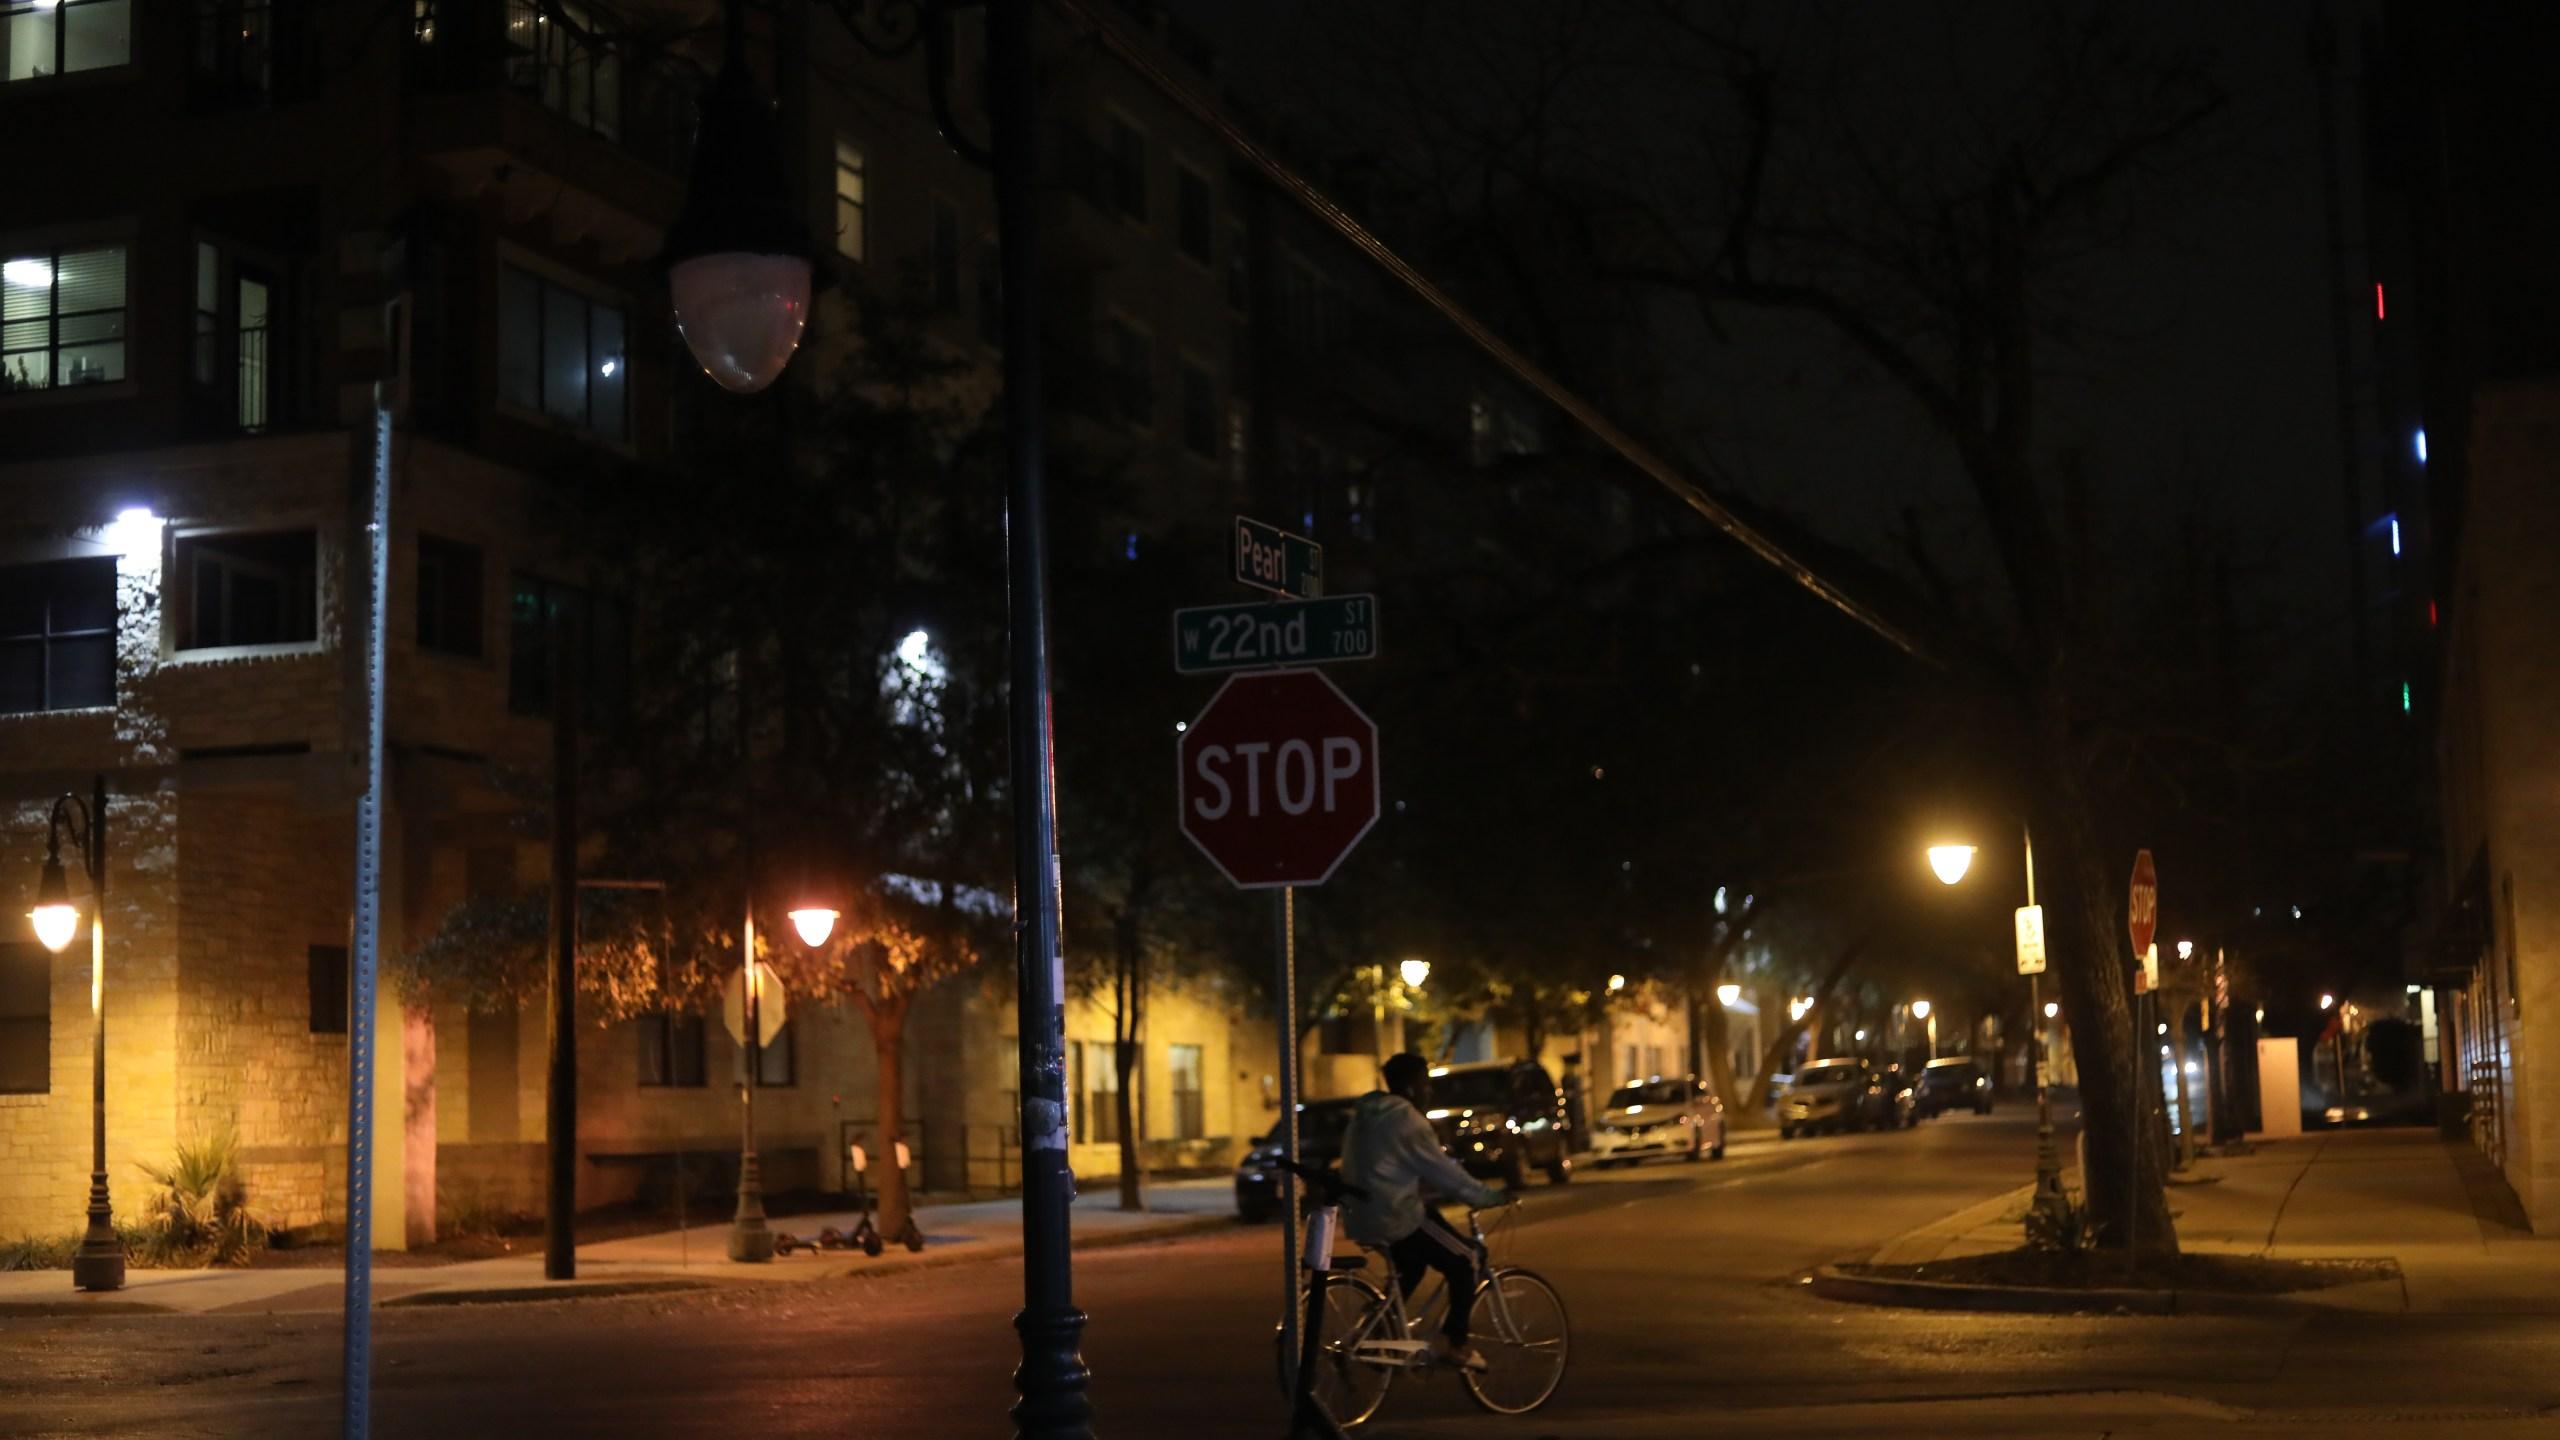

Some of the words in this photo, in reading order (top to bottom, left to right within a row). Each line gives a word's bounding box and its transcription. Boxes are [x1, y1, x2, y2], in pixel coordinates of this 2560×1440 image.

[1239, 526, 1286, 585] Pearl
[1345, 601, 1365, 625] ST
[1184, 628, 1200, 651] W
[1208, 611, 1306, 661] 22nd
[1332, 630, 1367, 653] 700
[1194, 736, 1362, 820] STOP
[2132, 884, 2155, 925] STOP
